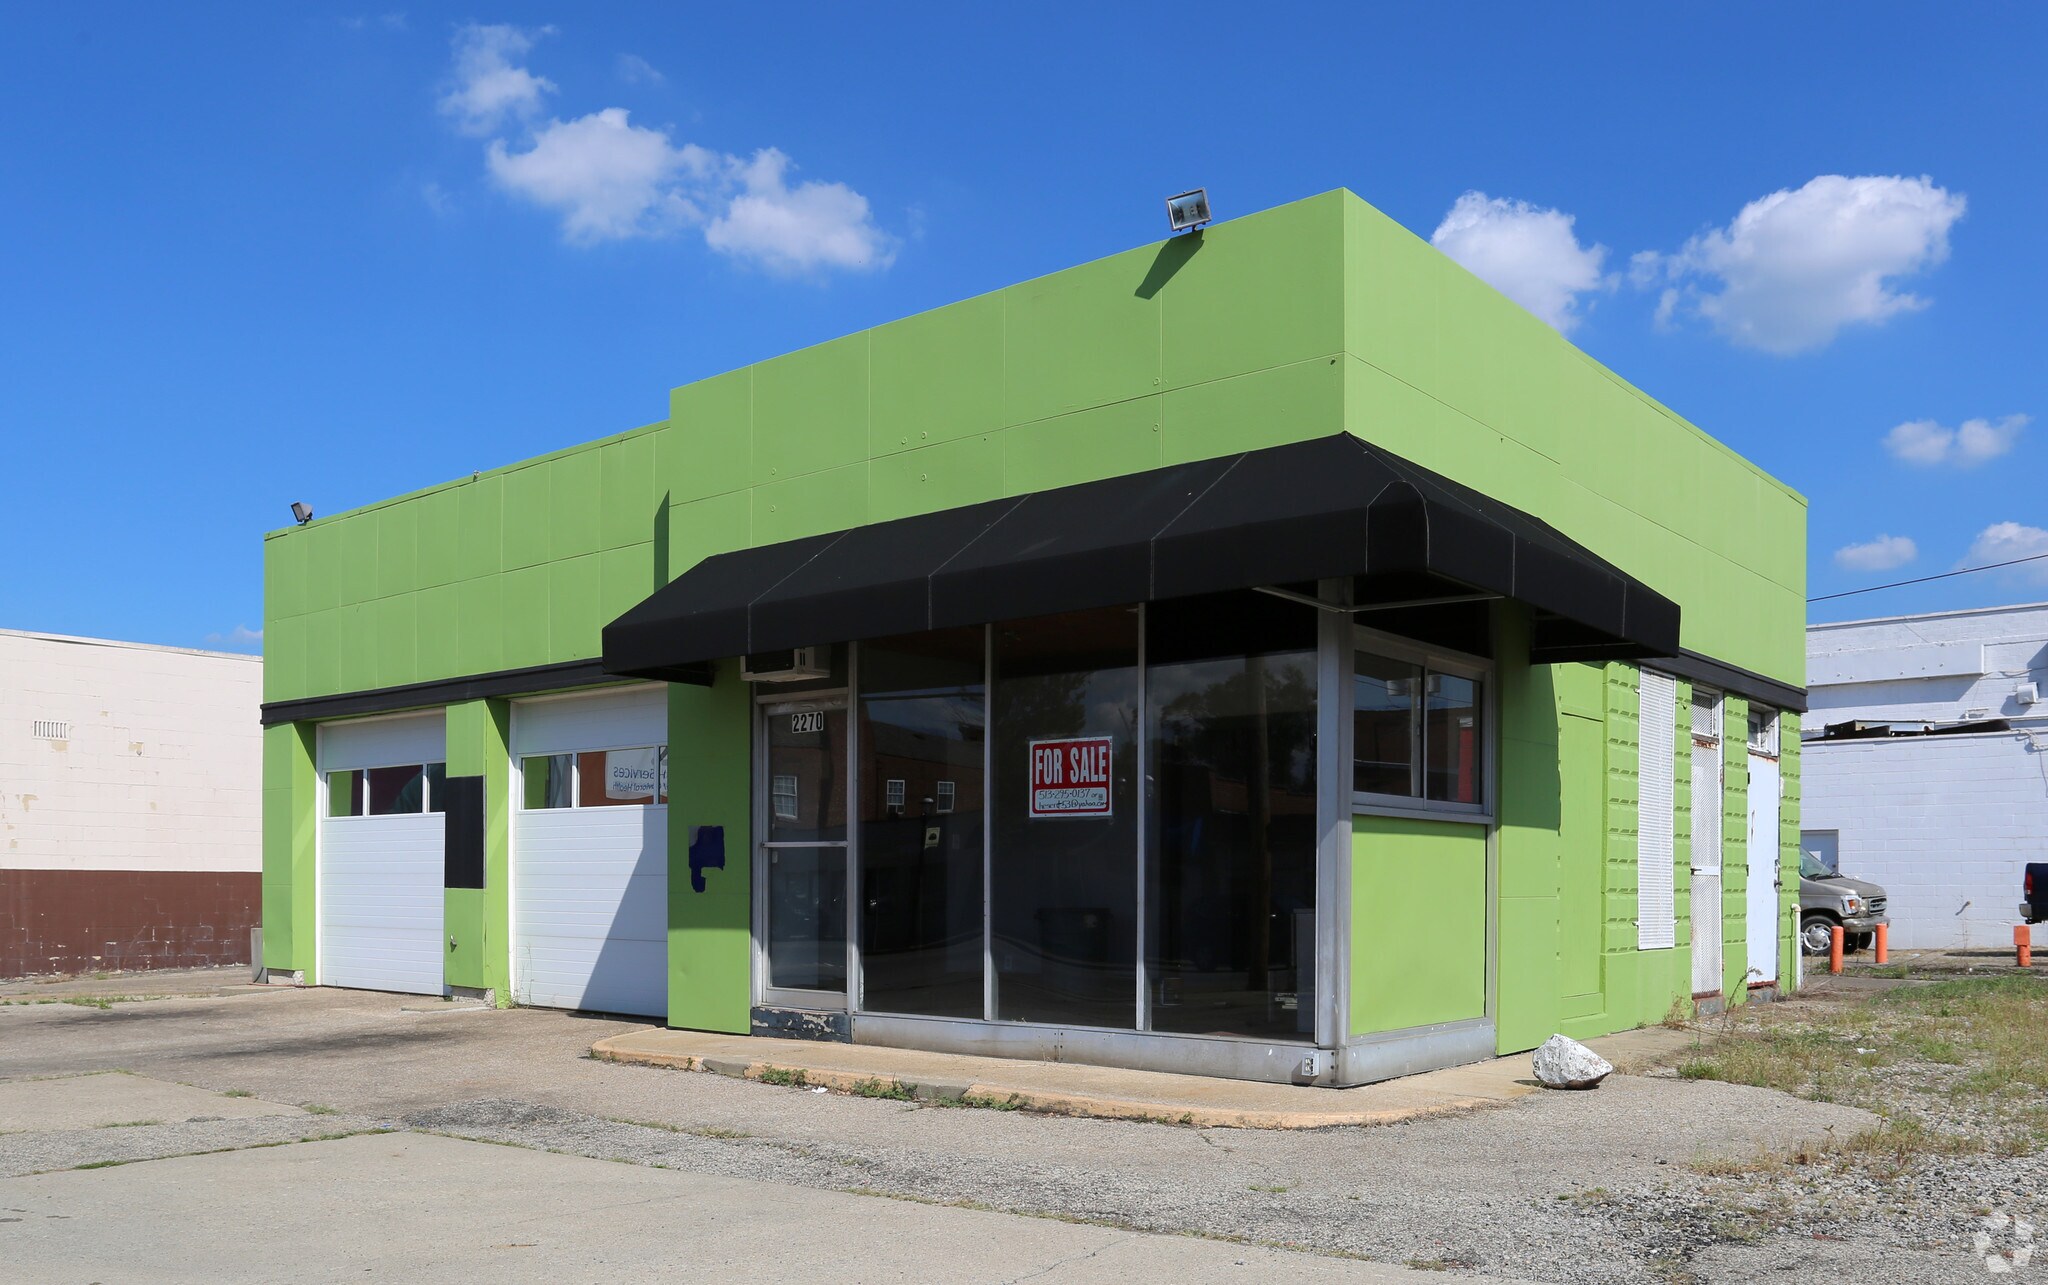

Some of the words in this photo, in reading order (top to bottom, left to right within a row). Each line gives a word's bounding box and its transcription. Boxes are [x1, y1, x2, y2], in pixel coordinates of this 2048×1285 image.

[793, 712, 823, 732] 2270
[1035, 748, 1063, 785] FOR
[1070, 746, 1107, 784] SALE
